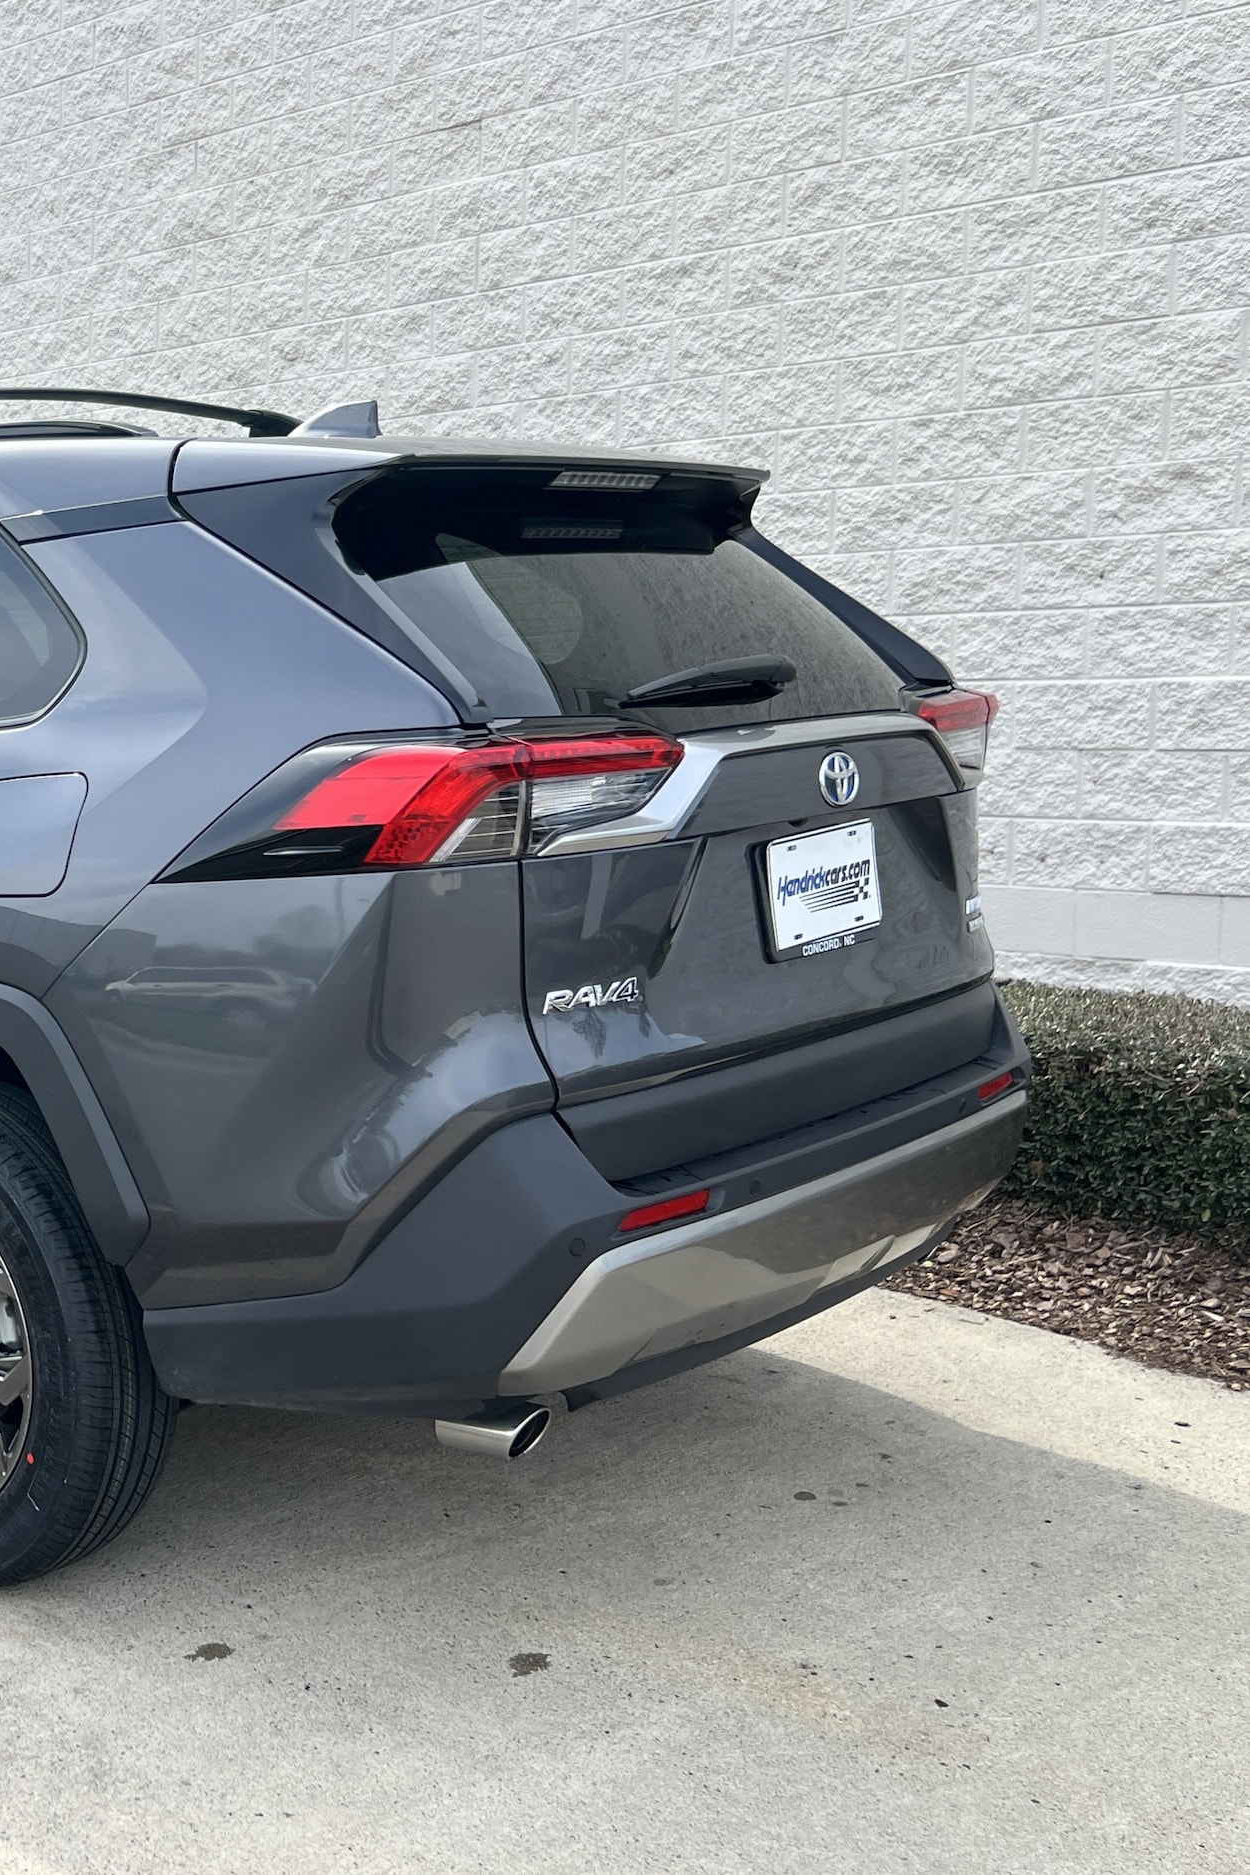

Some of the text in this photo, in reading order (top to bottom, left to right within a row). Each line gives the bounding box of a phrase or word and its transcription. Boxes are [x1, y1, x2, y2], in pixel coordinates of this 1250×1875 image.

[777, 859, 870, 906] Hendrickcars.com
[844, 934, 856, 946] NC
[542, 976, 639, 1015] RAV4
